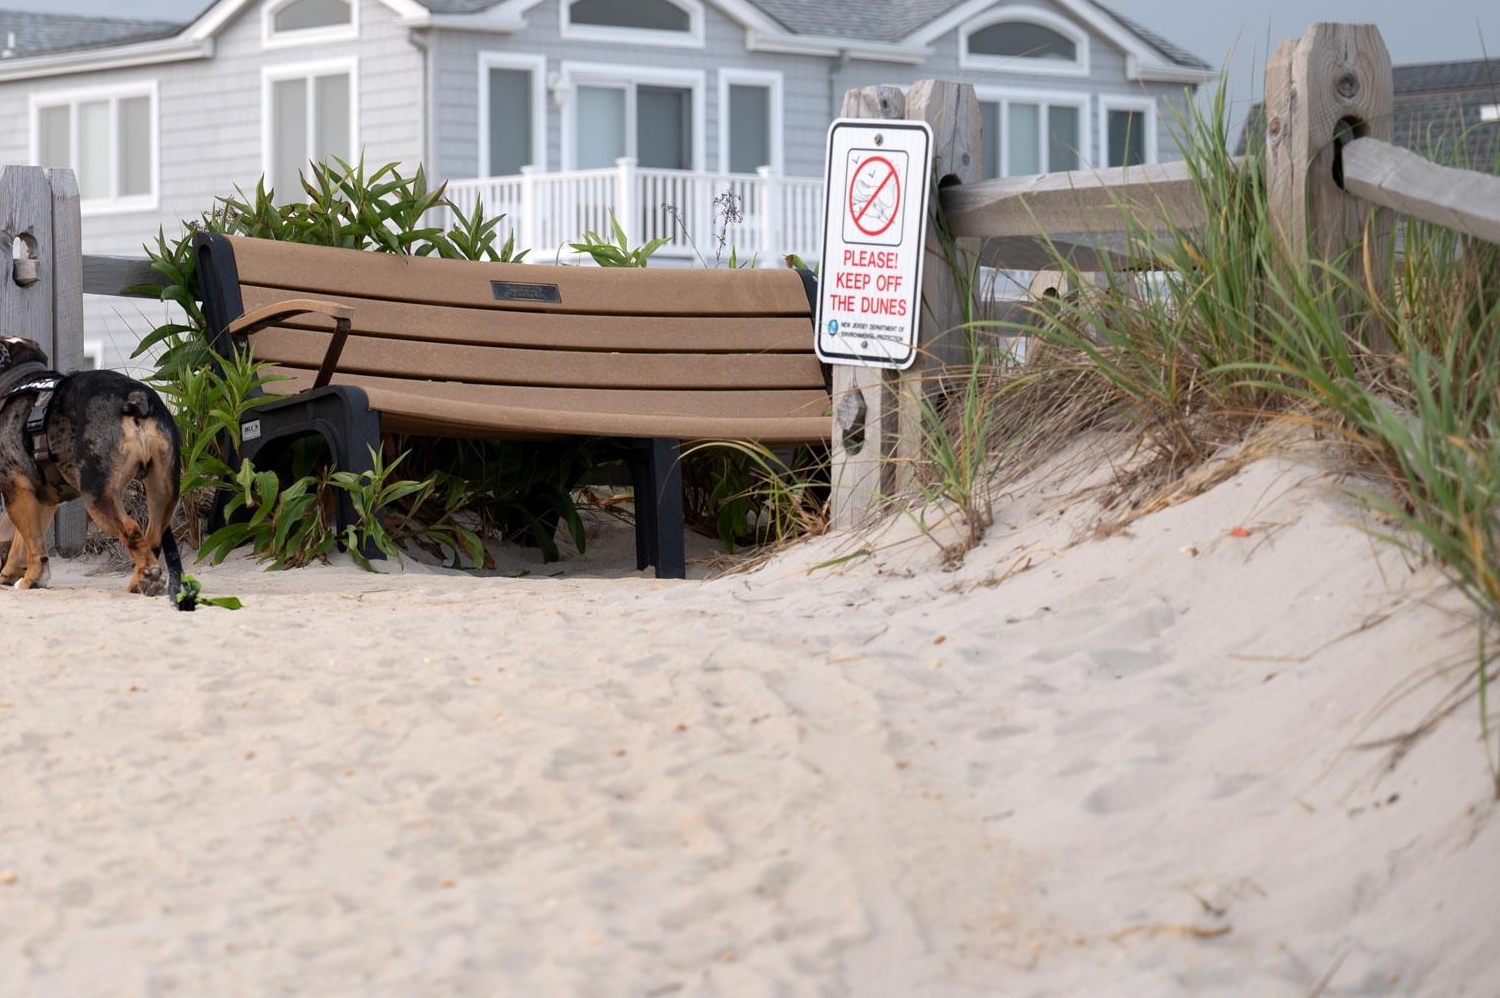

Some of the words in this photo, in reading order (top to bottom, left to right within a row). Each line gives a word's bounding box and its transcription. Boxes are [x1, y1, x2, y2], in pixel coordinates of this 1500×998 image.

[843, 250, 898, 269] PLEASE!
[836, 272, 871, 290] KEEP
[876, 274, 903, 292] OFF
[830, 294, 855, 312] THE
[861, 296, 907, 316] DUNES
[869, 324, 897, 332] DEPARTMENT
